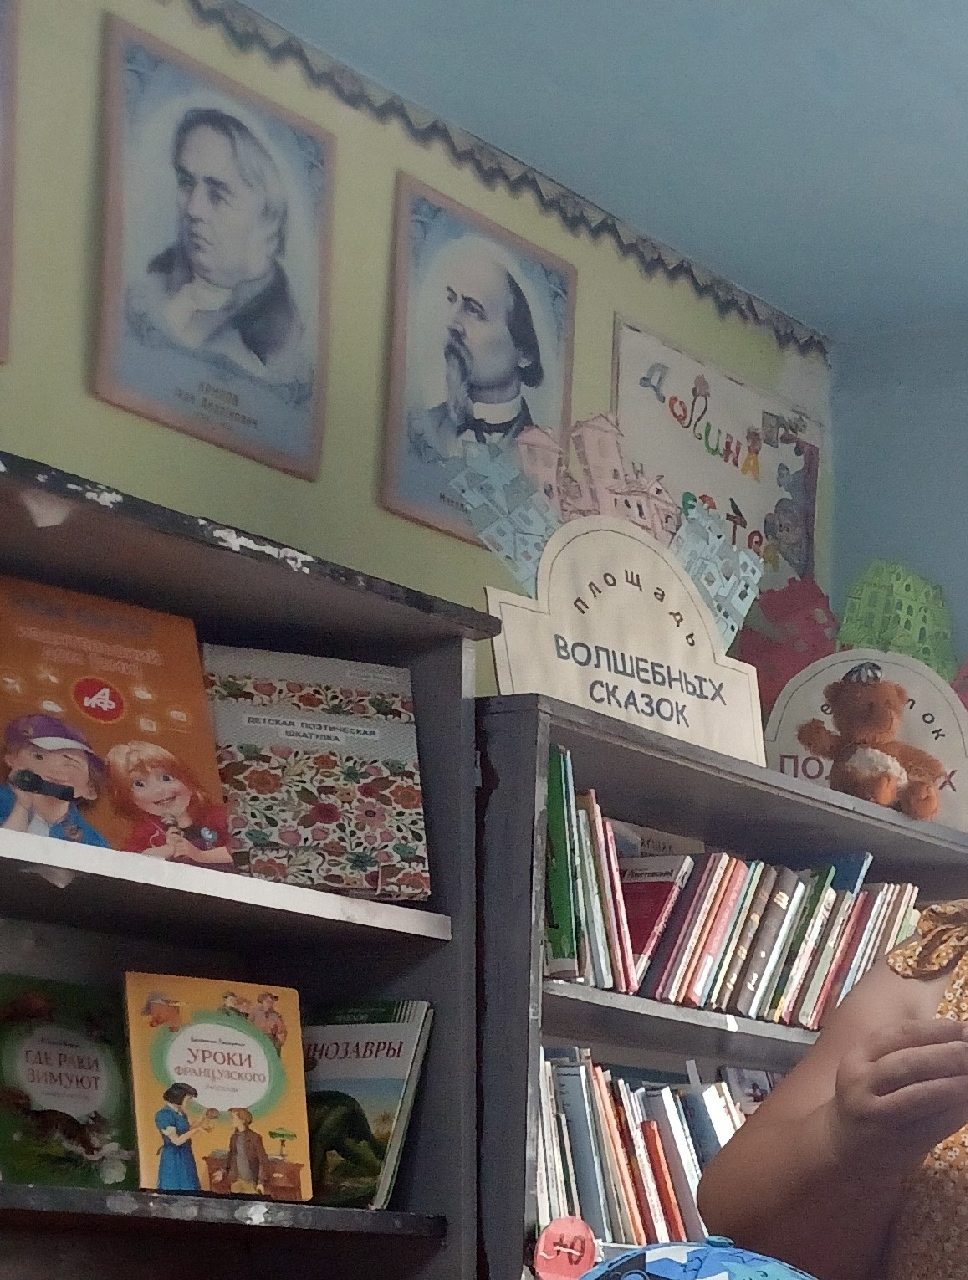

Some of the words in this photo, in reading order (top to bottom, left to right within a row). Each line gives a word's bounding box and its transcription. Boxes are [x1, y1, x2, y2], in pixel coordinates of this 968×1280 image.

[553, 633, 727, 705] ВОЛШЕБНЫХ
[589, 679, 689, 728] СКАЗОК
[24, 1049, 54, 1066] ГДЕ
[58, 1052, 100, 1071] РАКИ
[186, 1047, 252, 1069] УРОКИ
[27, 1067, 100, 1090] ЗИМУЮТ
[174, 1065, 267, 1083] ФРАНЦУЗСКОГО
